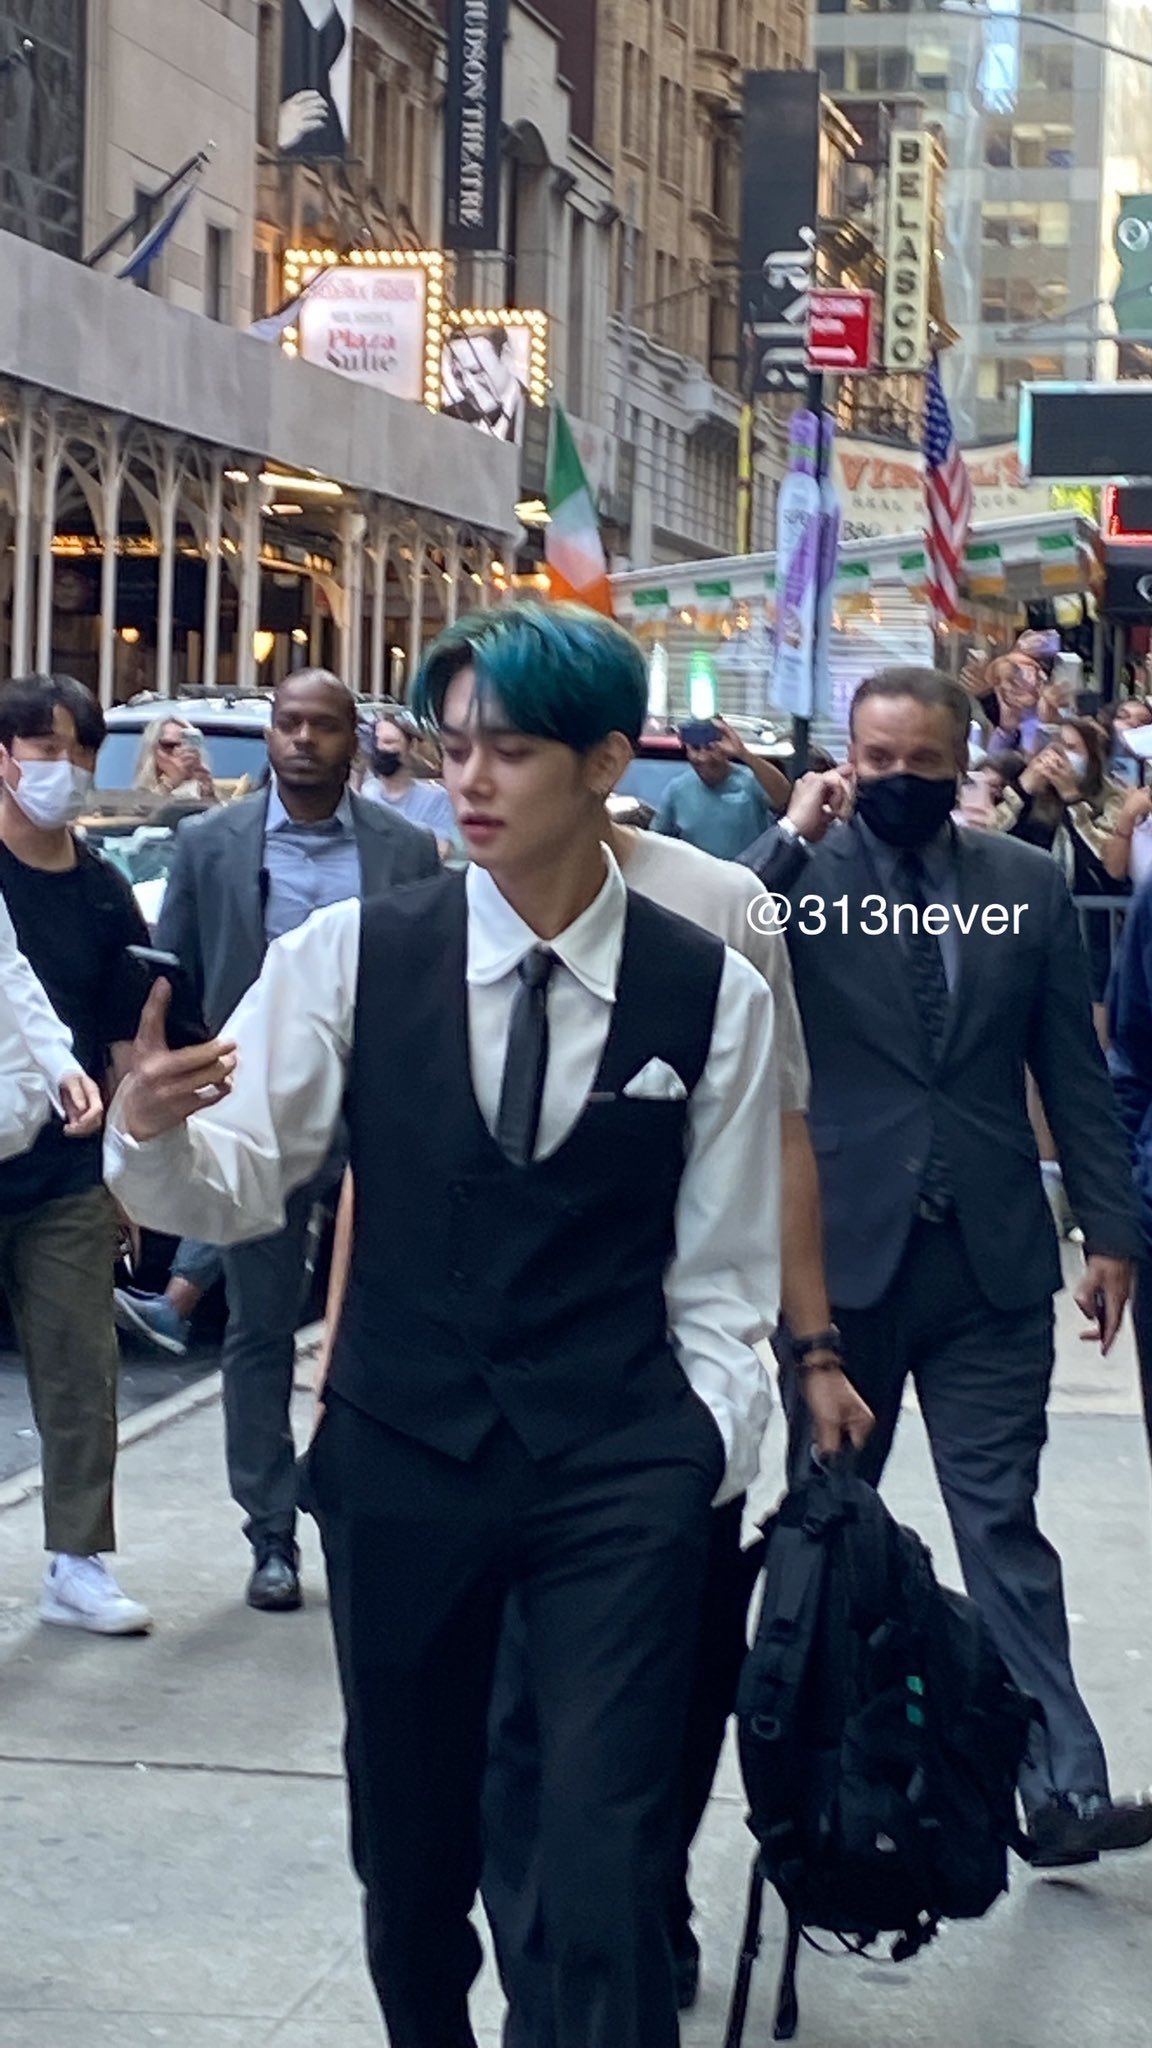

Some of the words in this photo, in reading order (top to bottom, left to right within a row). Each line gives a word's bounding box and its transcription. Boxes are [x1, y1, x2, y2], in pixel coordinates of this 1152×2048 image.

[459, 101, 487, 229] THEATRE
[892, 138, 921, 362] BELASCO
[326, 350, 399, 372] Suite
[328, 329, 397, 351] Plaza
